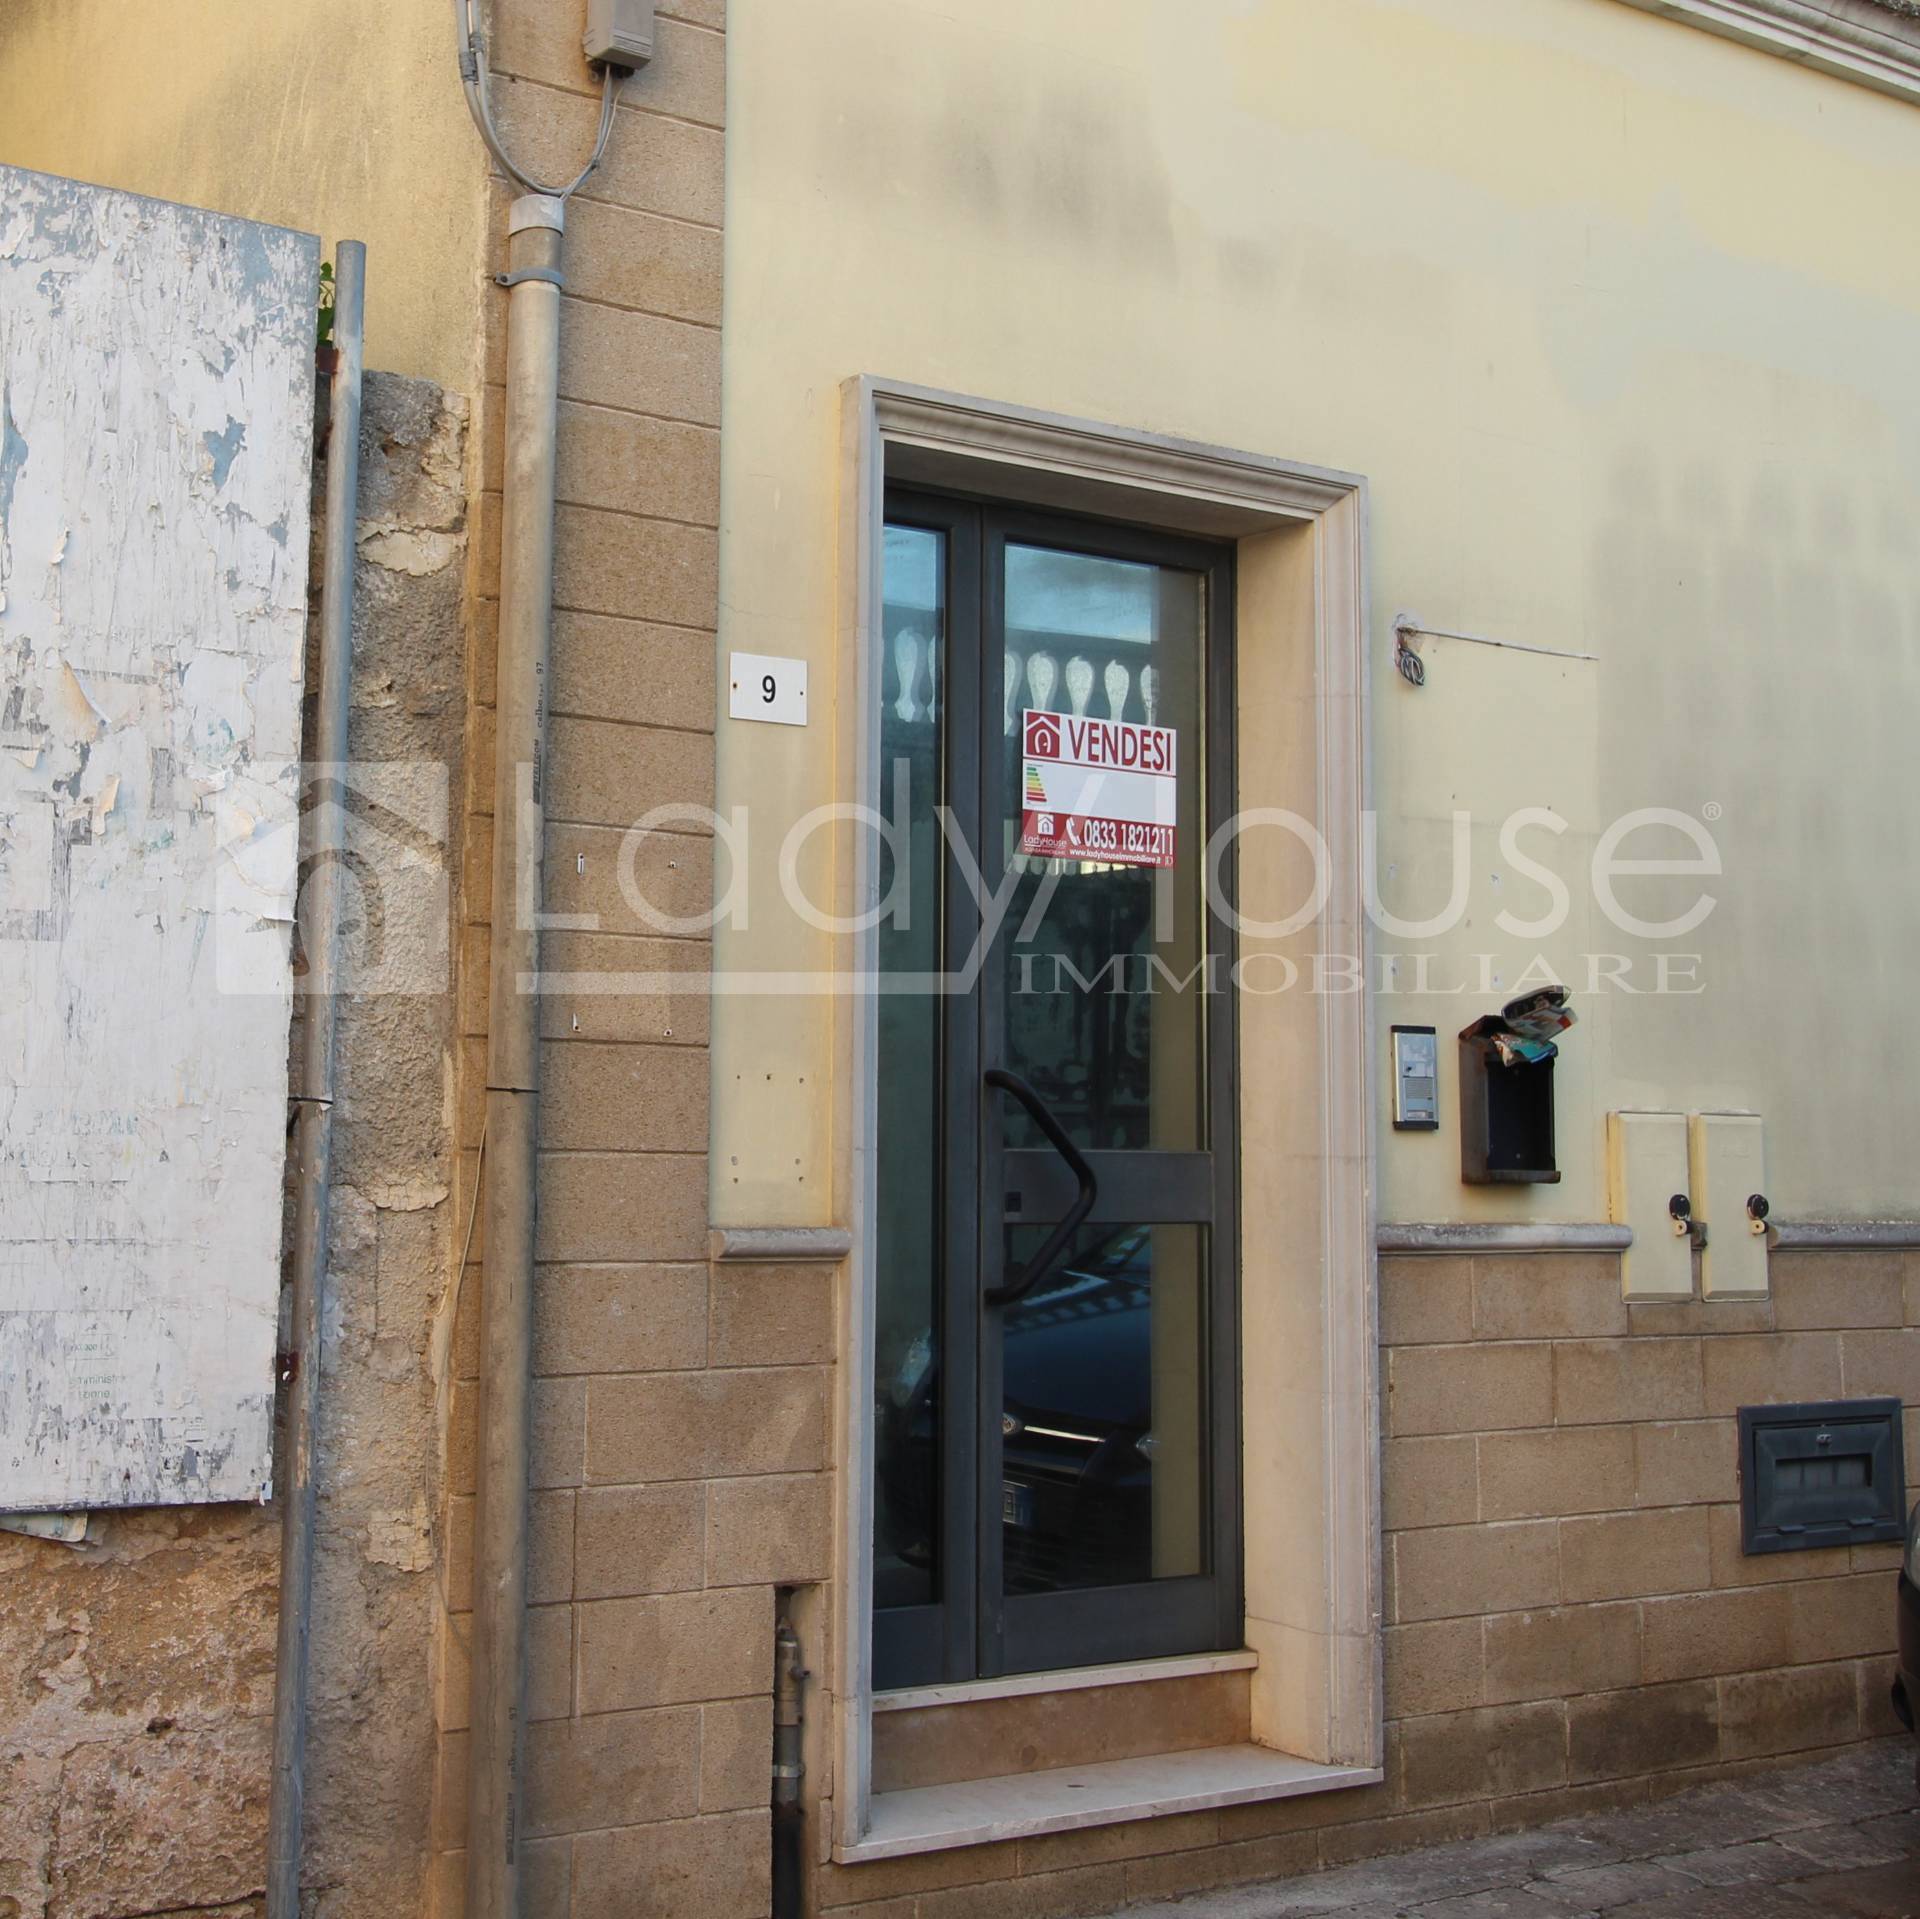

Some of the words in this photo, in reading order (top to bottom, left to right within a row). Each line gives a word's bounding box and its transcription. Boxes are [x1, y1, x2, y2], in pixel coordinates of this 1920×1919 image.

[536, 662, 544, 675] 97
[762, 675, 776, 703] 9
[1068, 719, 1171, 772] VENDESI
[1084, 819, 1117, 849] 0833
[1121, 824, 1174, 855] 1821211
[1069, 848, 1161, 865] www.ladyhouseimmobiliare.it
